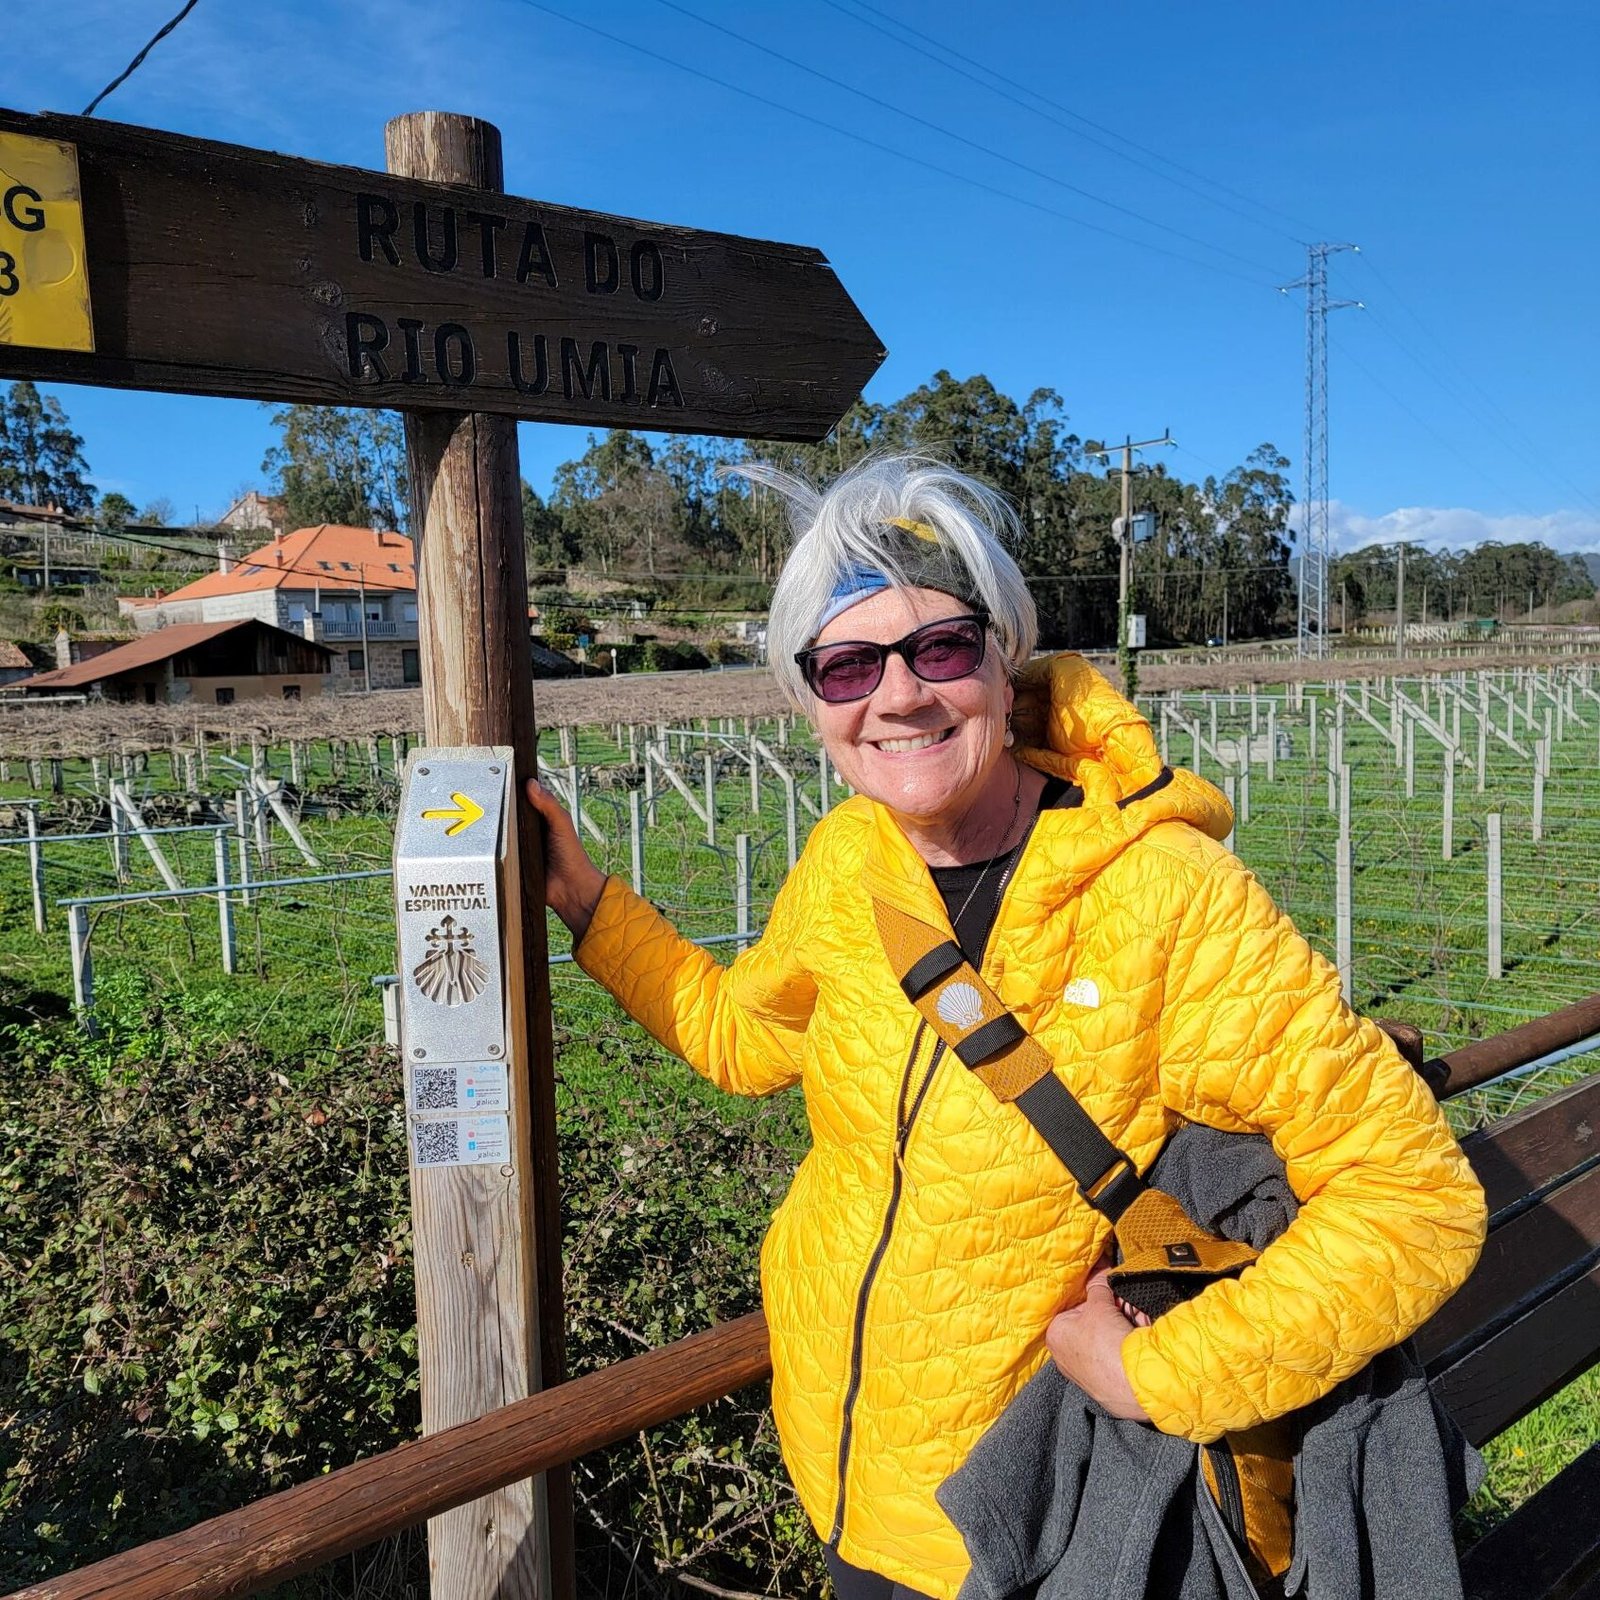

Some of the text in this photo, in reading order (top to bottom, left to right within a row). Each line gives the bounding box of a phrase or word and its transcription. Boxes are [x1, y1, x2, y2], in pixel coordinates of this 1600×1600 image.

[0, 186, 46, 232] G
[356, 192, 666, 302] RUTA DO
[345, 311, 686, 409] RIO UMIA
[404, 897, 491, 912] ESPIRITUAL
[408, 882, 486, 898] VARIANTE
